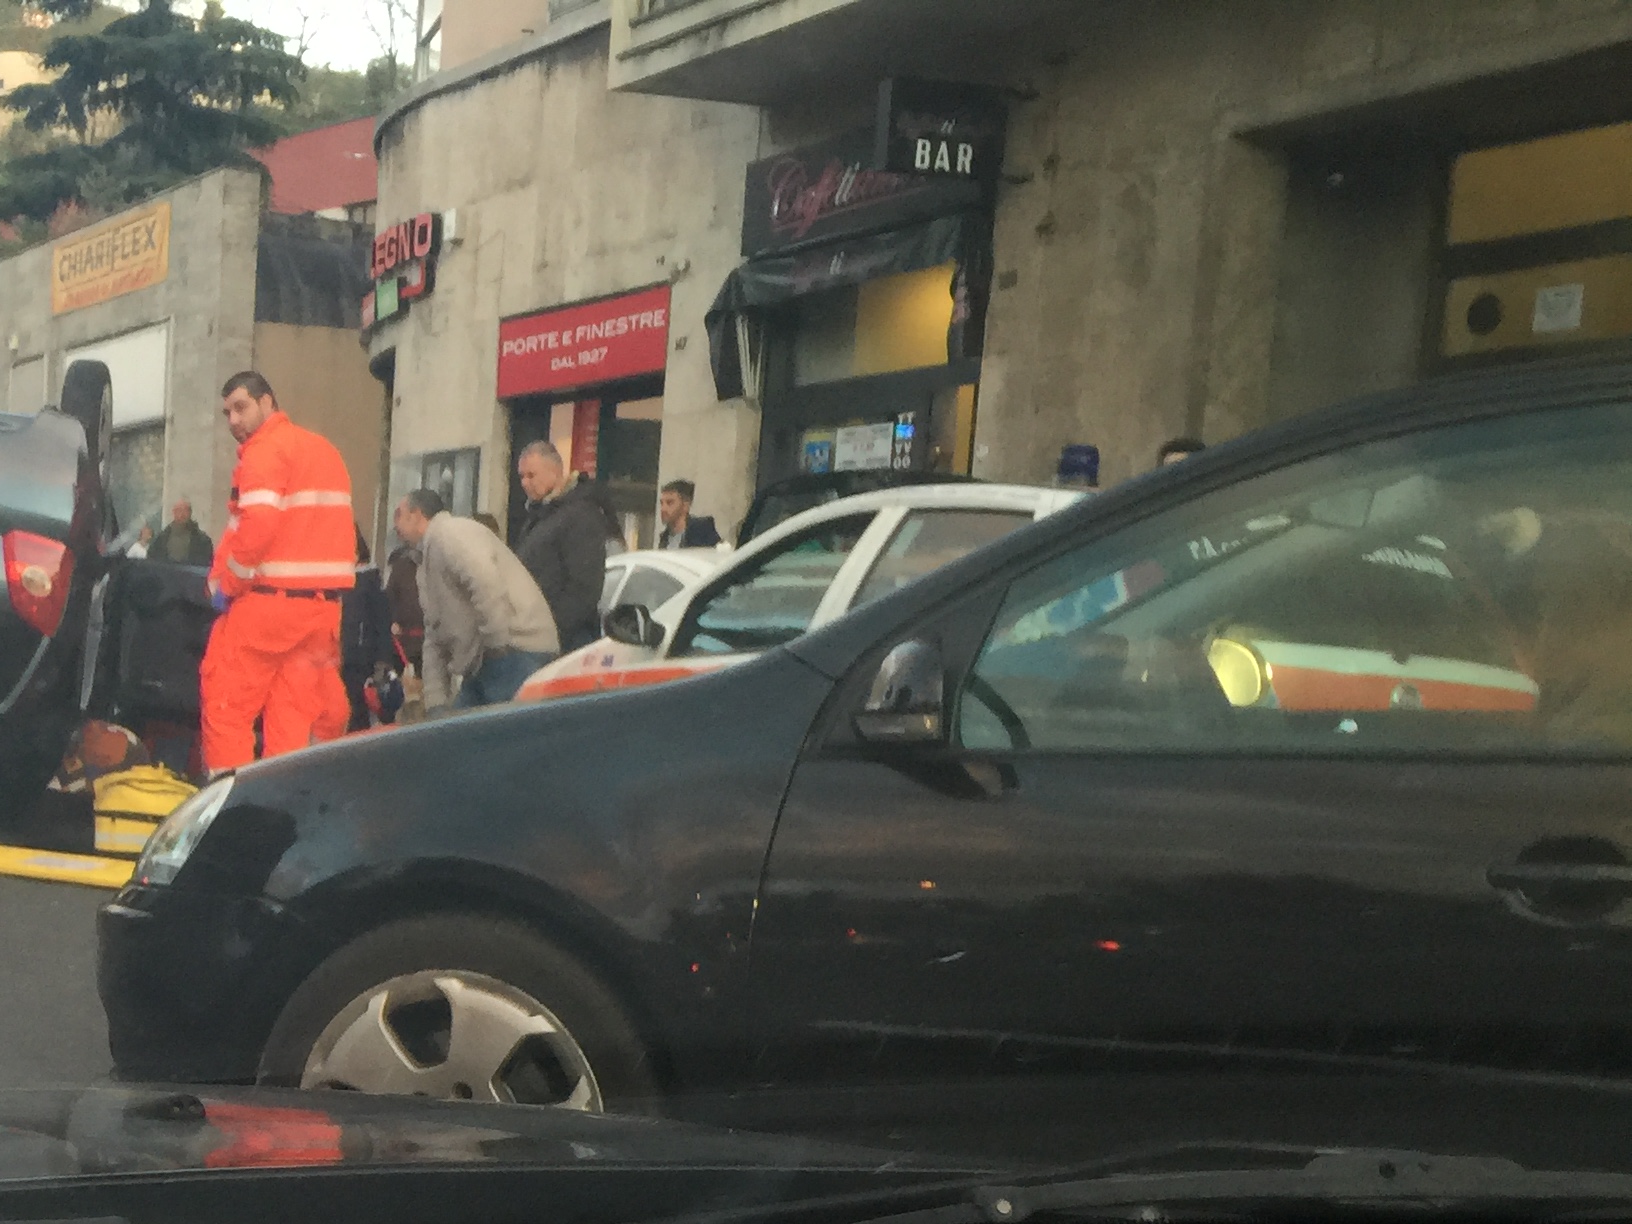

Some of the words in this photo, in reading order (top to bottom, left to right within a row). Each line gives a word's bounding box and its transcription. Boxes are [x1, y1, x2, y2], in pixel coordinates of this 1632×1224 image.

[914, 138, 973, 174] BAR
[502, 331, 559, 357] PORTE
[575, 308, 666, 344] FINESTRE
[550, 356, 575, 371] DAL
